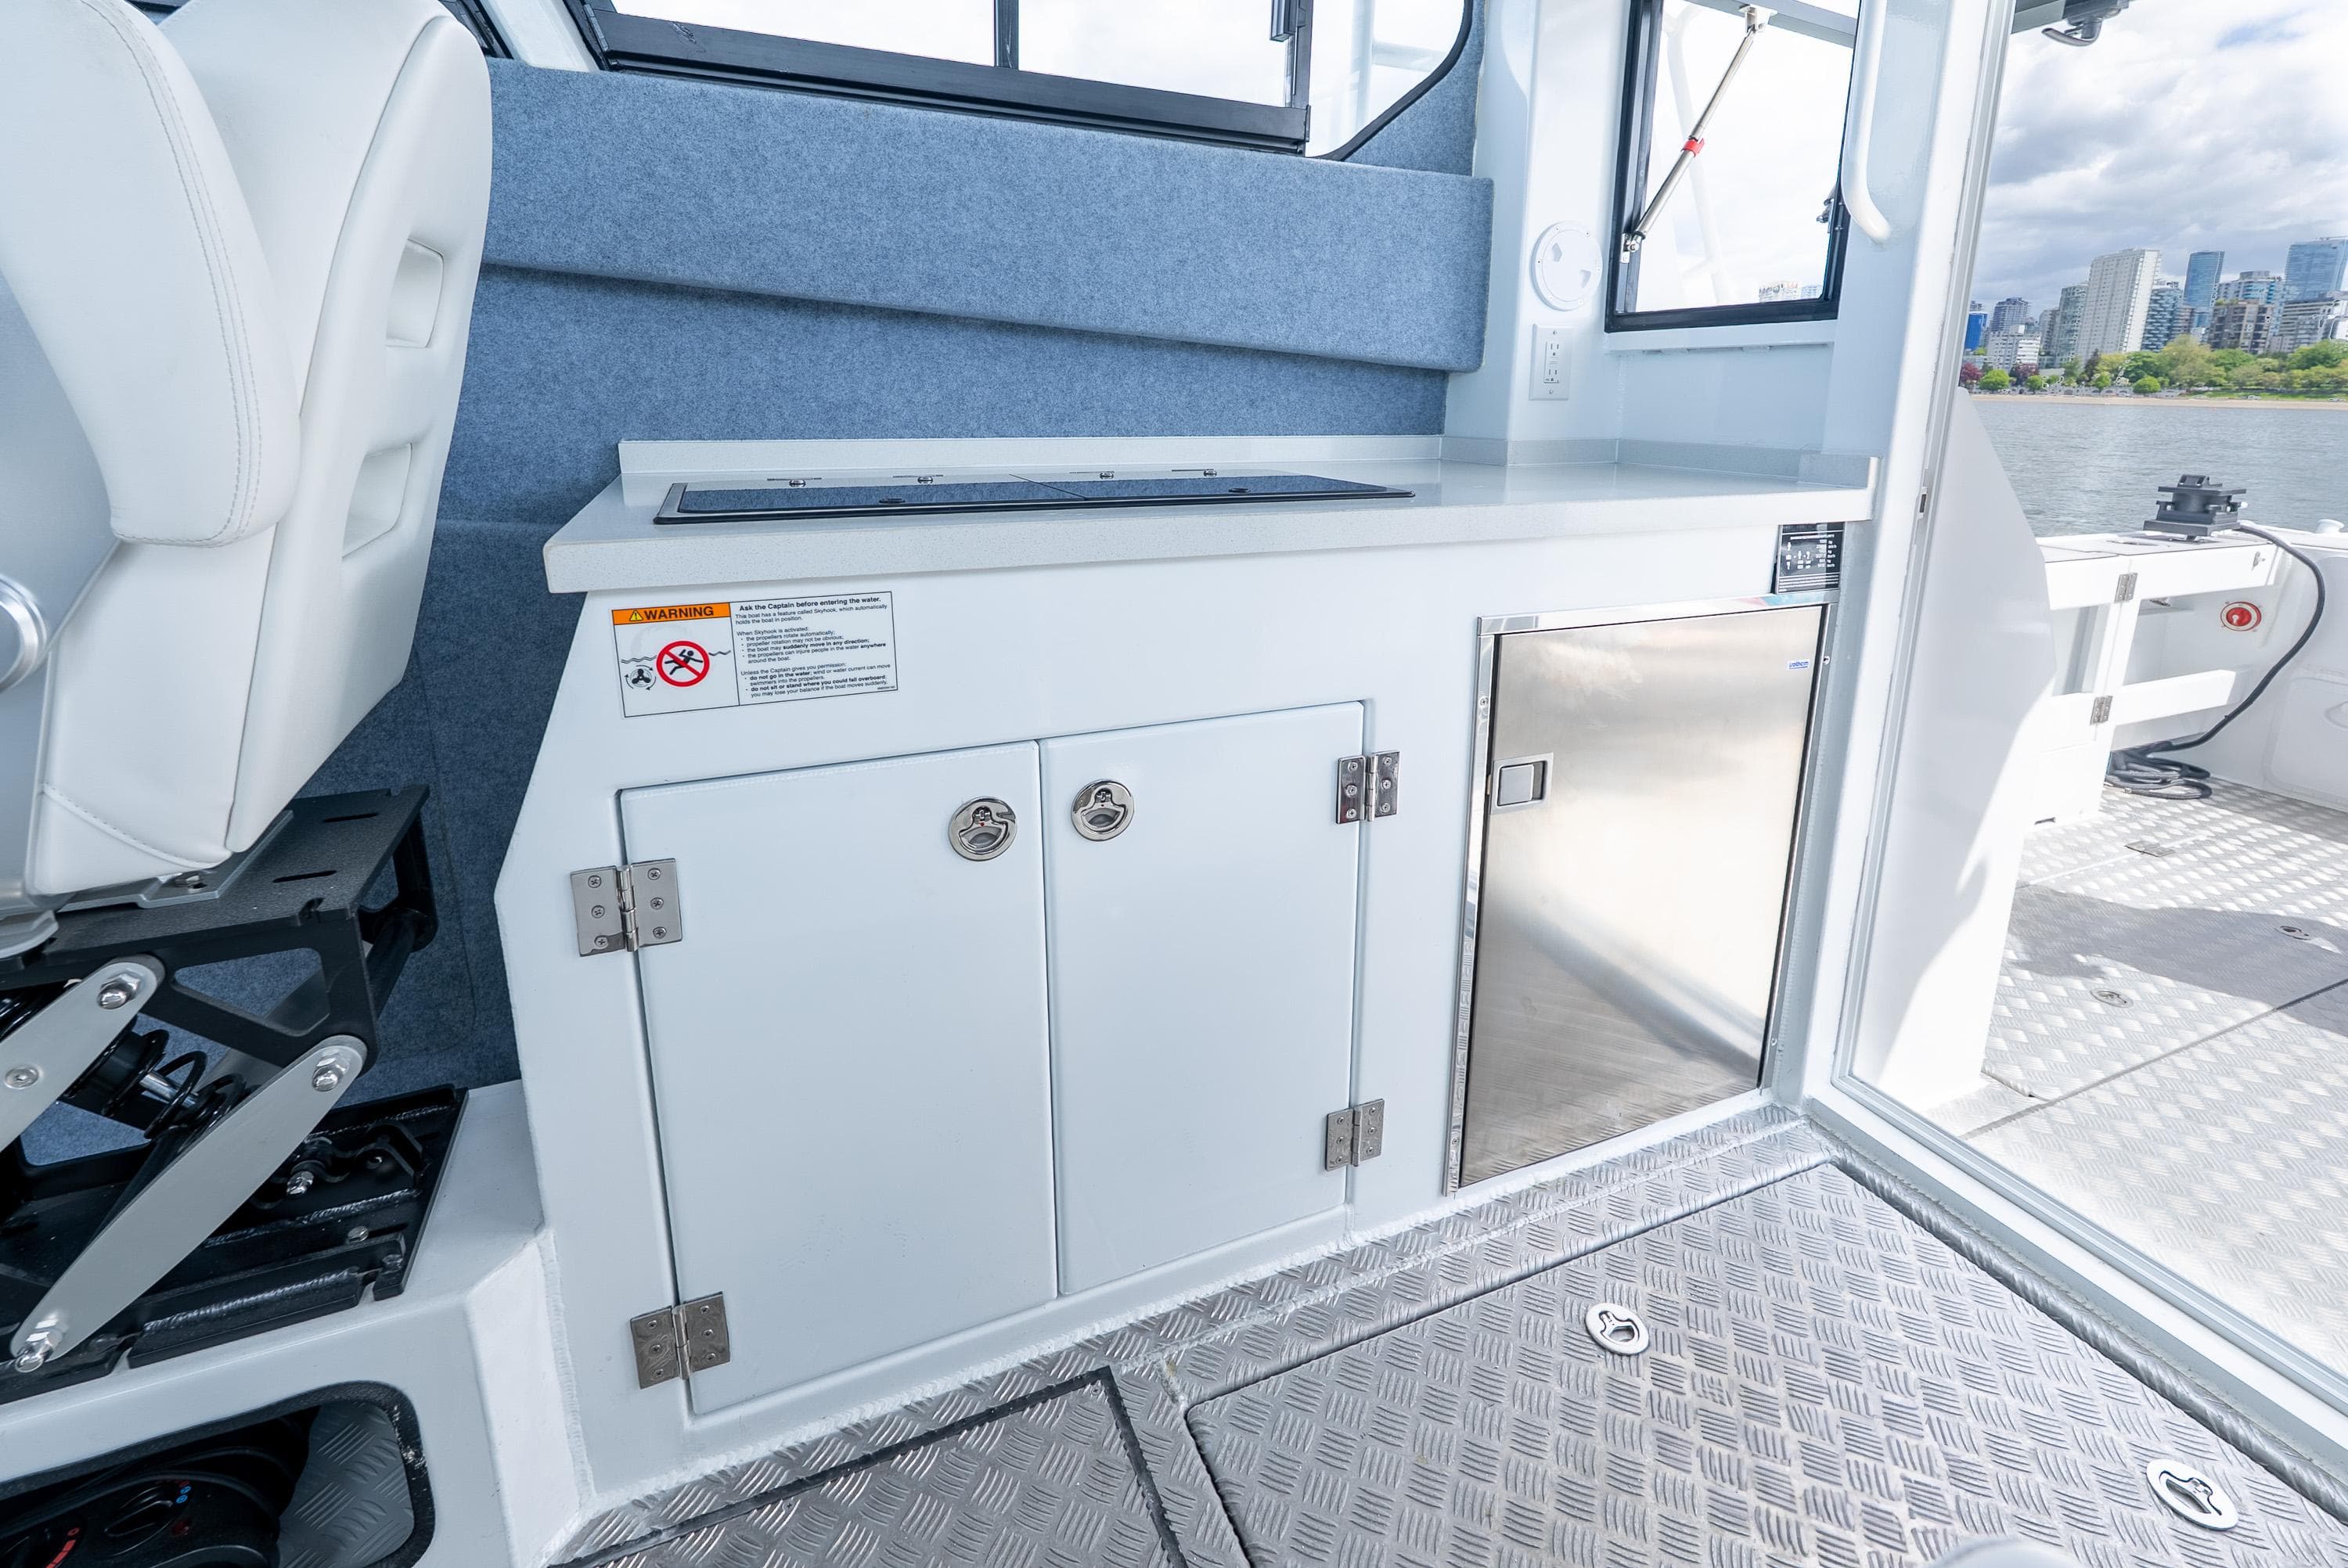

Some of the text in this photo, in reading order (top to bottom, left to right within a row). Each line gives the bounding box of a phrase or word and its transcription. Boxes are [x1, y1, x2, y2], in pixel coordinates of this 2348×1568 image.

[767, 602, 795, 610] Captain
[819, 599, 848, 607] entering
[643, 606, 714, 620] WARNING
